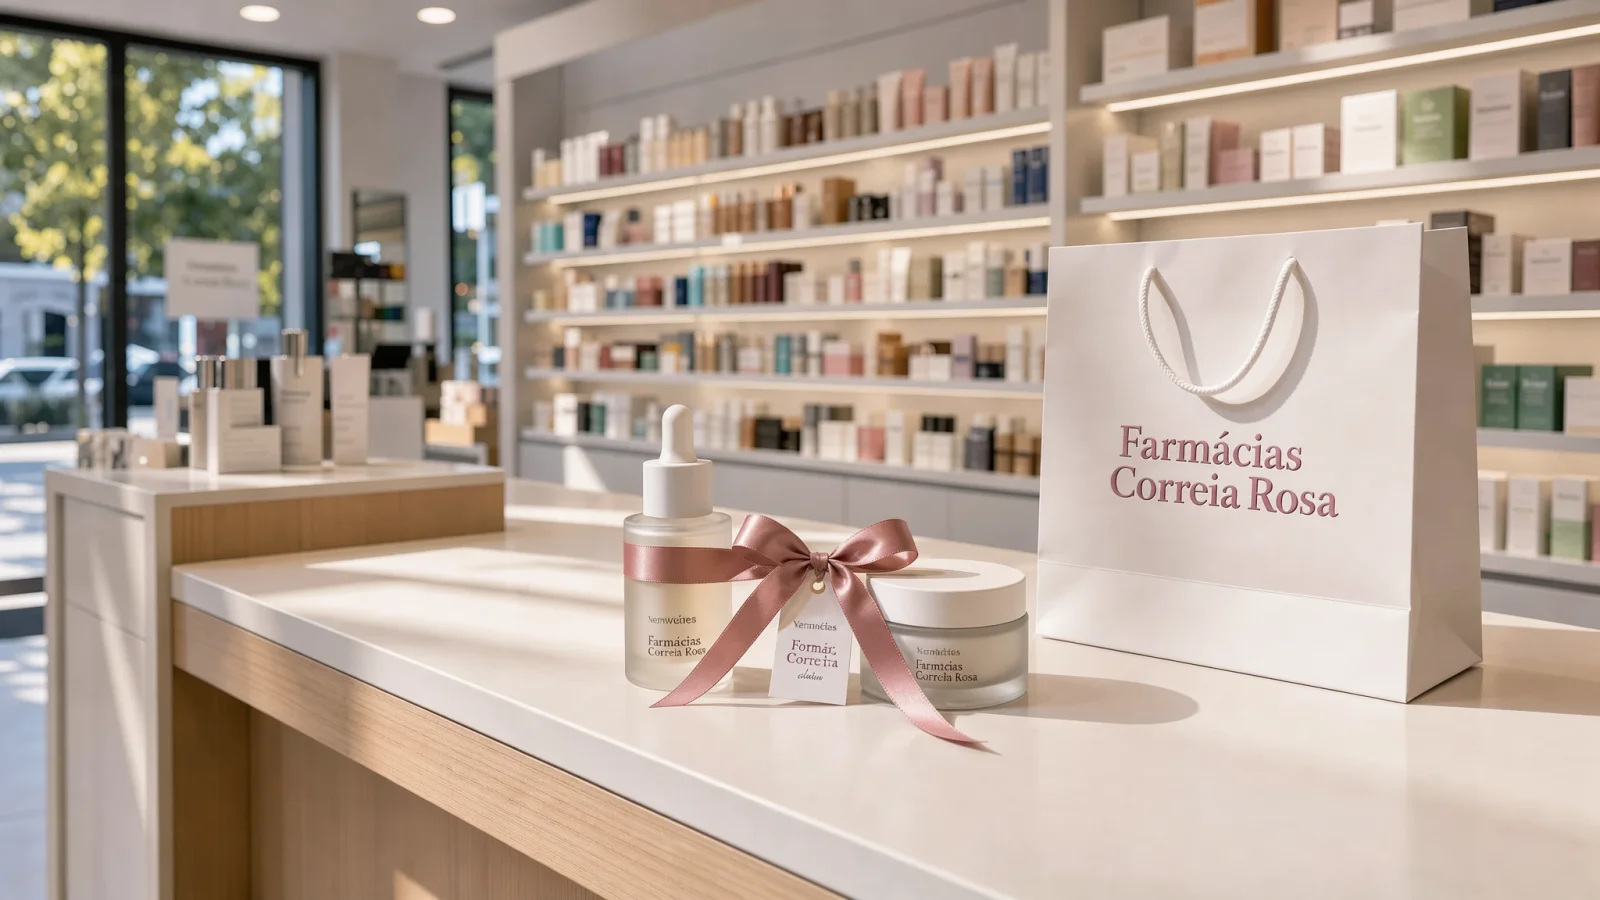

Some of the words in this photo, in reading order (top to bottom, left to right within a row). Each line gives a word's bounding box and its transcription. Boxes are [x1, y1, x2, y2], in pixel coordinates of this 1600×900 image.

[1119, 424, 1303, 472] Farmácias
[1110, 465, 1241, 510] Correia
[1248, 476, 1340, 518] Rosa
[647, 635, 702, 647] Farmácias
[955, 672, 979, 682] Rosa
